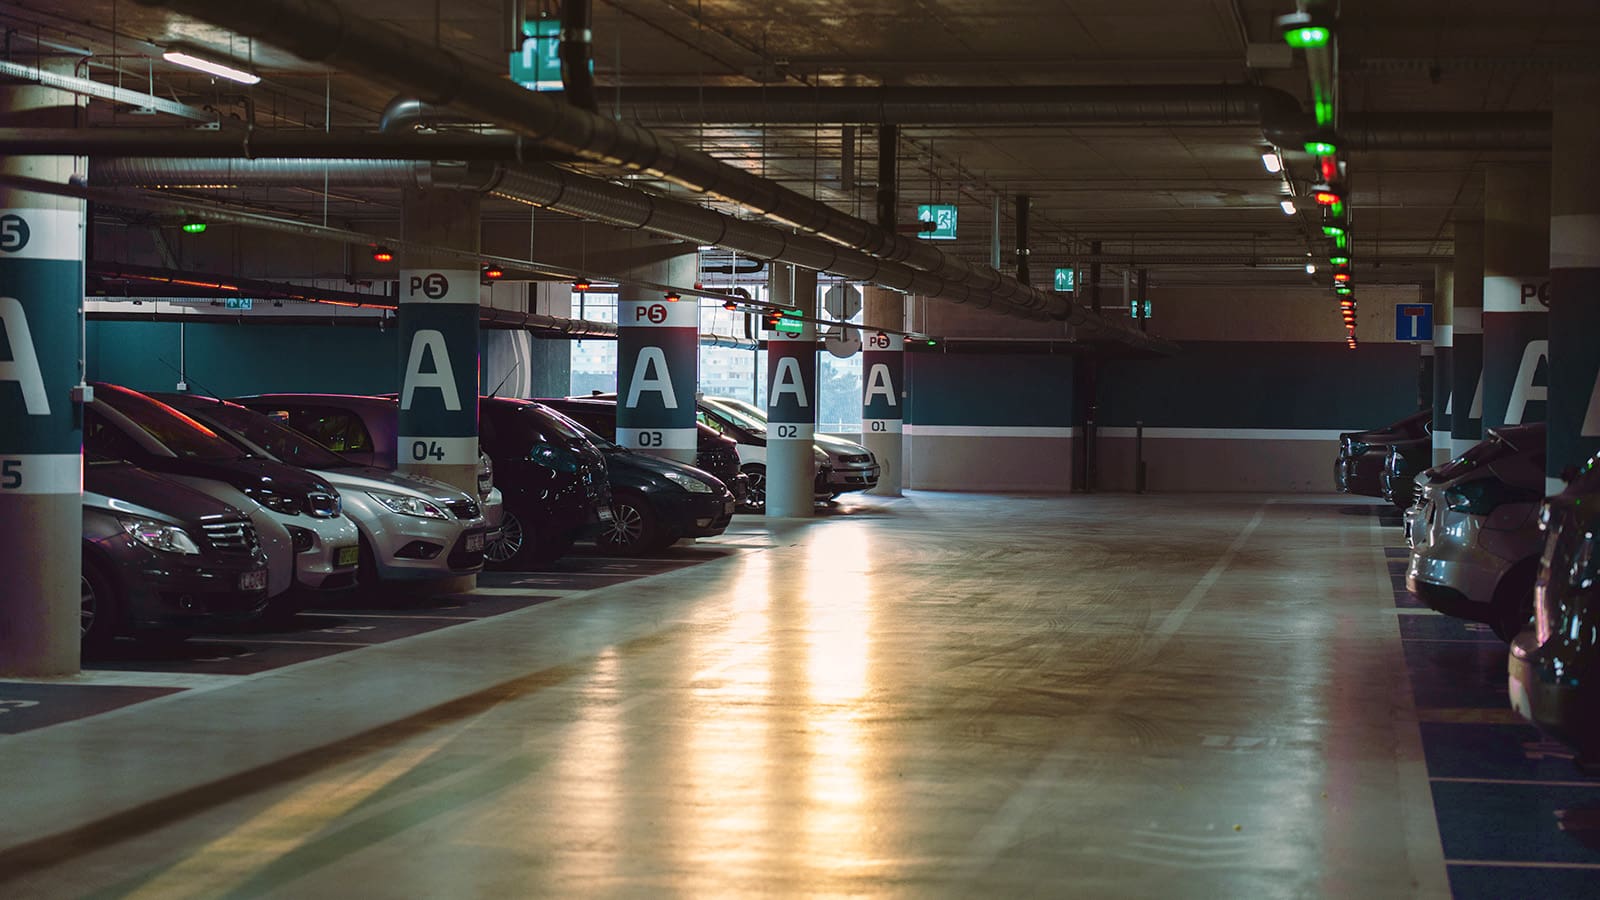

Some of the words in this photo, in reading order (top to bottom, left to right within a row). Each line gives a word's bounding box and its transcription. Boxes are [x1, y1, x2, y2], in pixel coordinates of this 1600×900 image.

[410, 272, 449, 299] P5
[636, 304, 667, 324] P5
[869, 333, 890, 349] P5
[400, 330, 462, 410] A
[625, 347, 678, 408] A
[769, 356, 809, 407] A
[864, 363, 897, 406] A
[777, 425, 797, 438] 02
[871, 421, 887, 431] 01
[639, 431, 663, 447] 03
[412, 441, 445, 461] 04
[2, 459, 22, 489] 5
